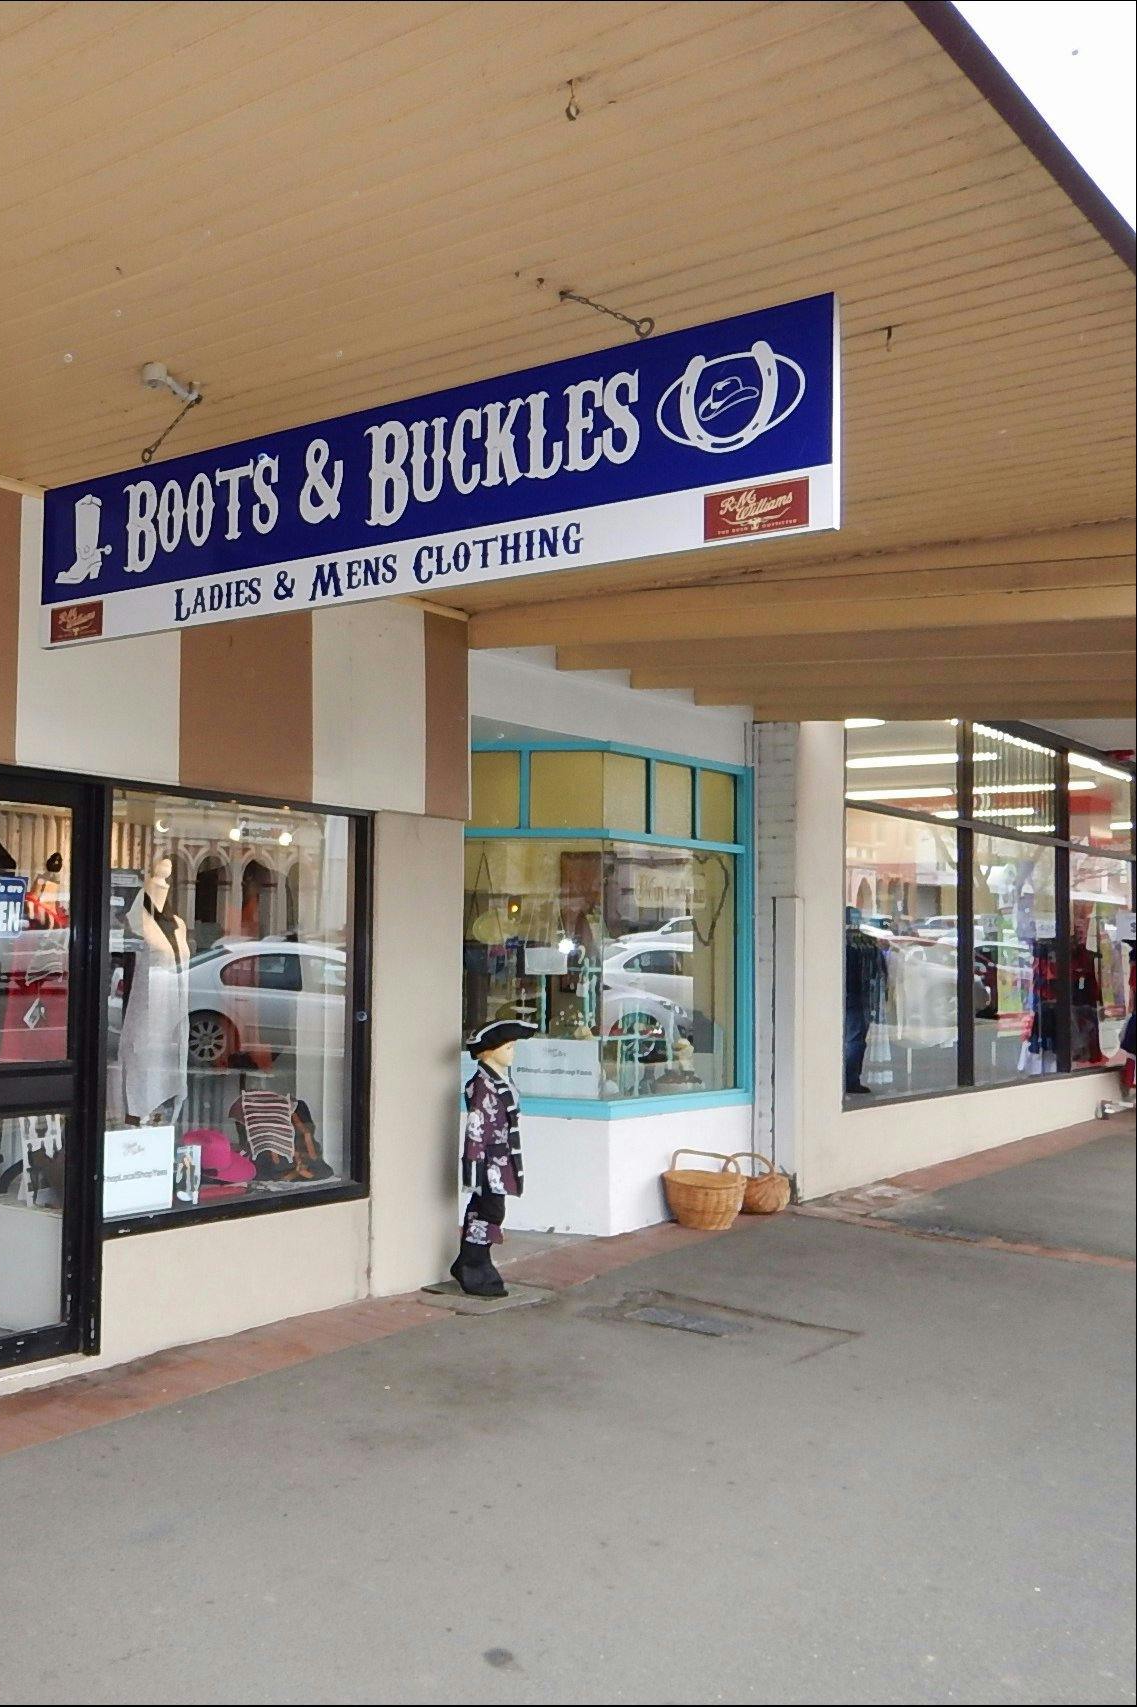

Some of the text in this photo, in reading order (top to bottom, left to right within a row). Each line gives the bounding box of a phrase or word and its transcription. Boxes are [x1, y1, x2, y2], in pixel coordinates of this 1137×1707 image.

[123, 369, 640, 573] BOOTS & BUCKLES
[735, 492, 793, 521] Williams
[174, 522, 584, 622] LADIES & MENS CLOTHING
